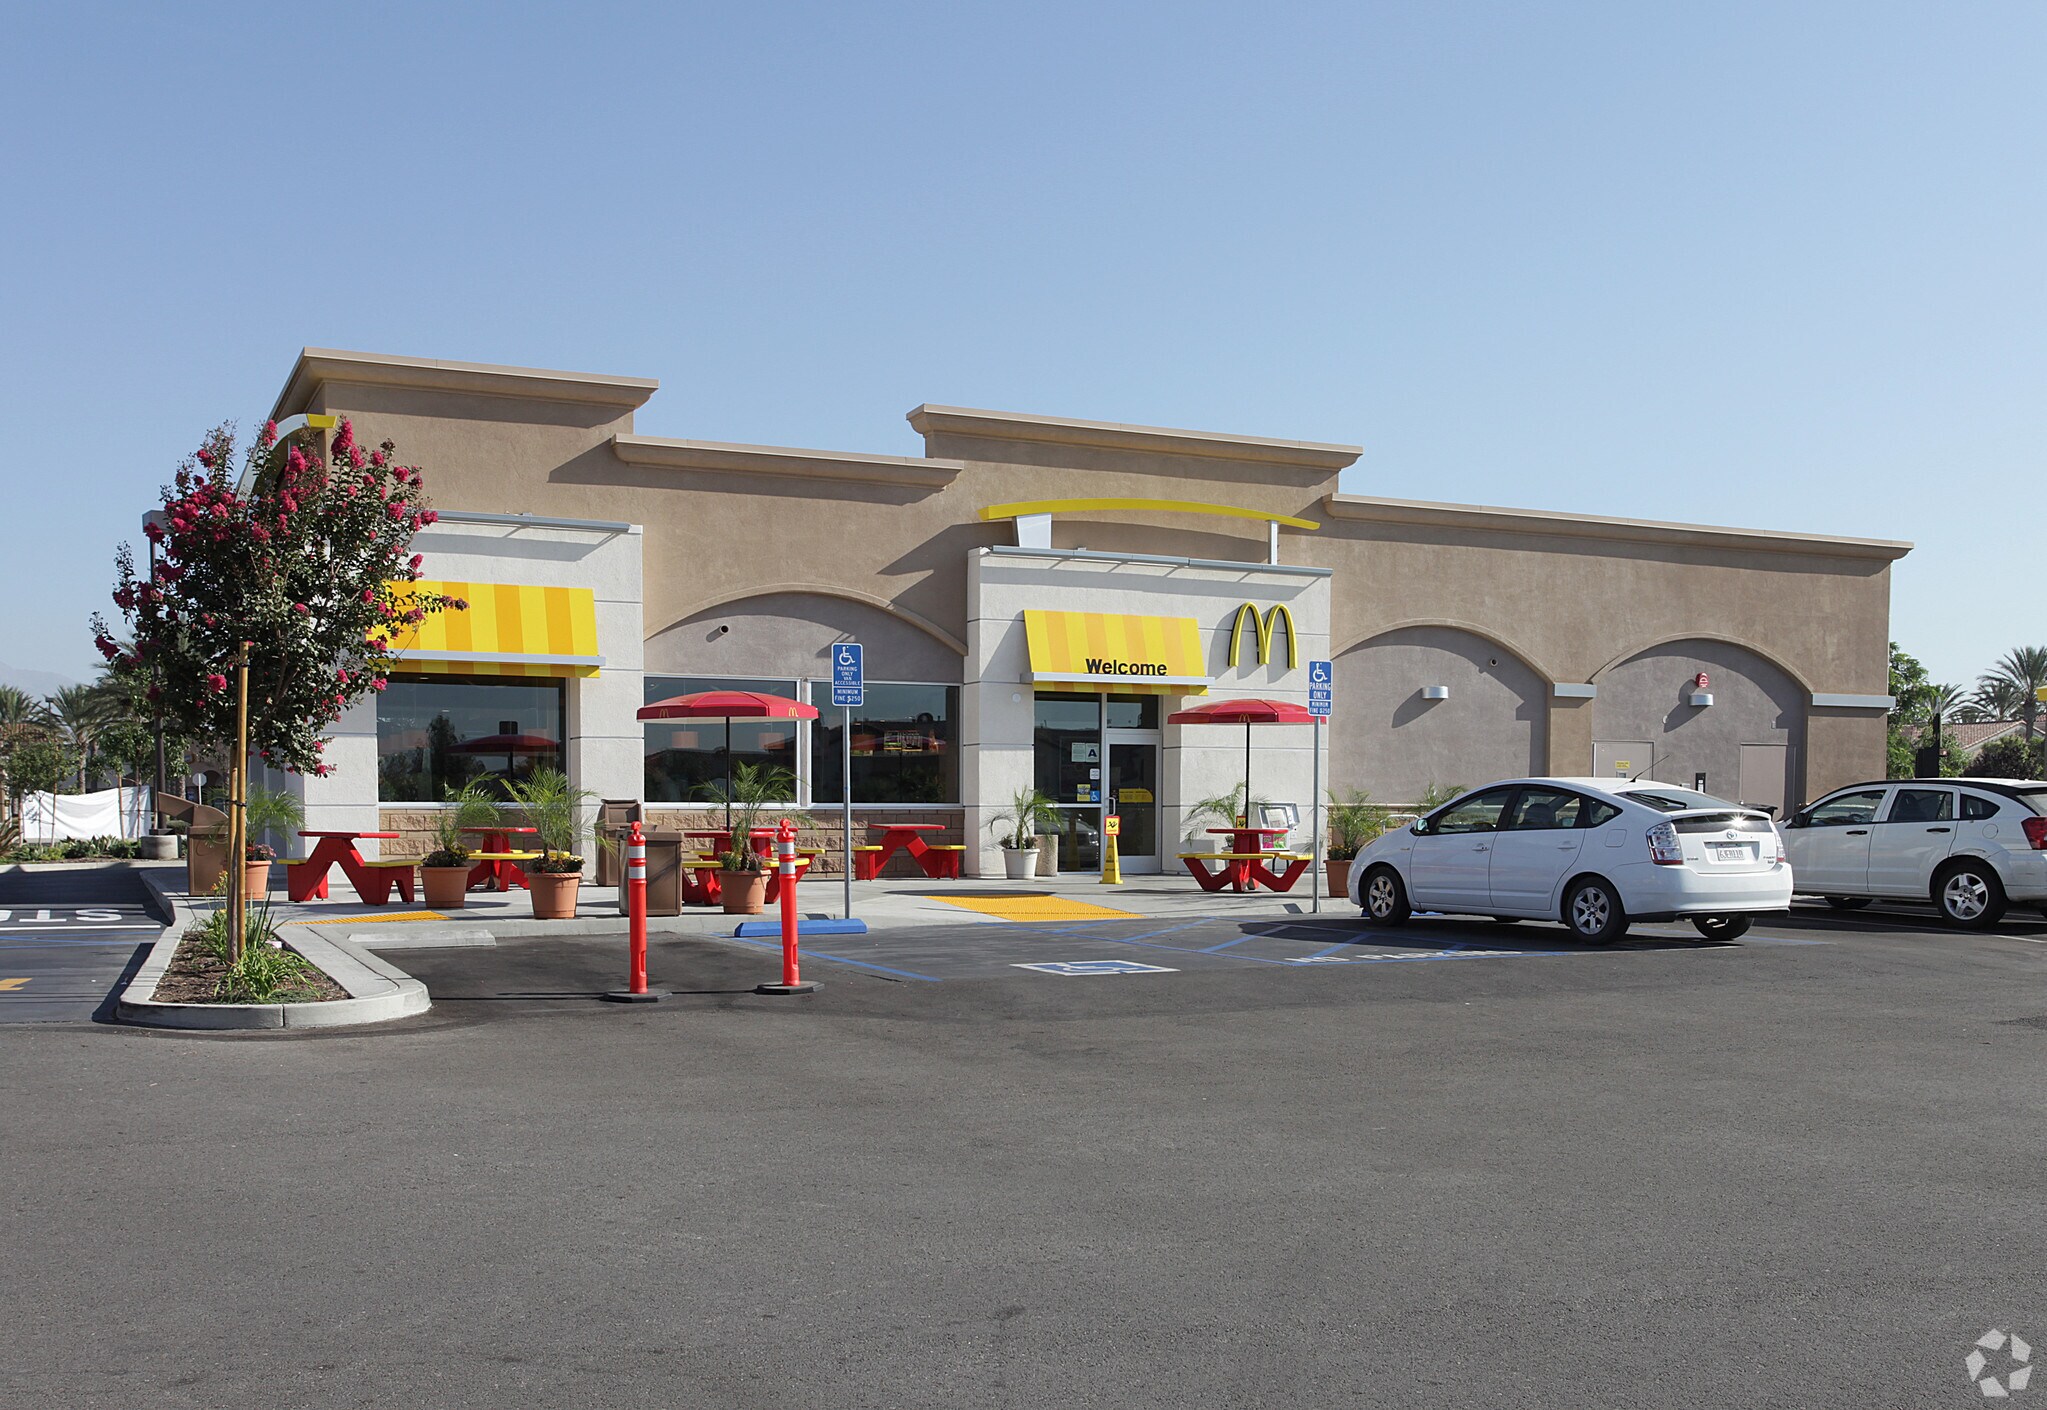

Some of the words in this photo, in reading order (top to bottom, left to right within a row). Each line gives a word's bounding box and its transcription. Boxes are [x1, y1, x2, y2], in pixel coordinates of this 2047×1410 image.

[1228, 602, 1298, 669] M
[1085, 658, 1168, 676] Welcome
[1309, 682, 1331, 691] PARKING
[1313, 690, 1327, 699] ONLY
[1088, 749, 1097, 757] A
[0, 909, 122, 923] ST
